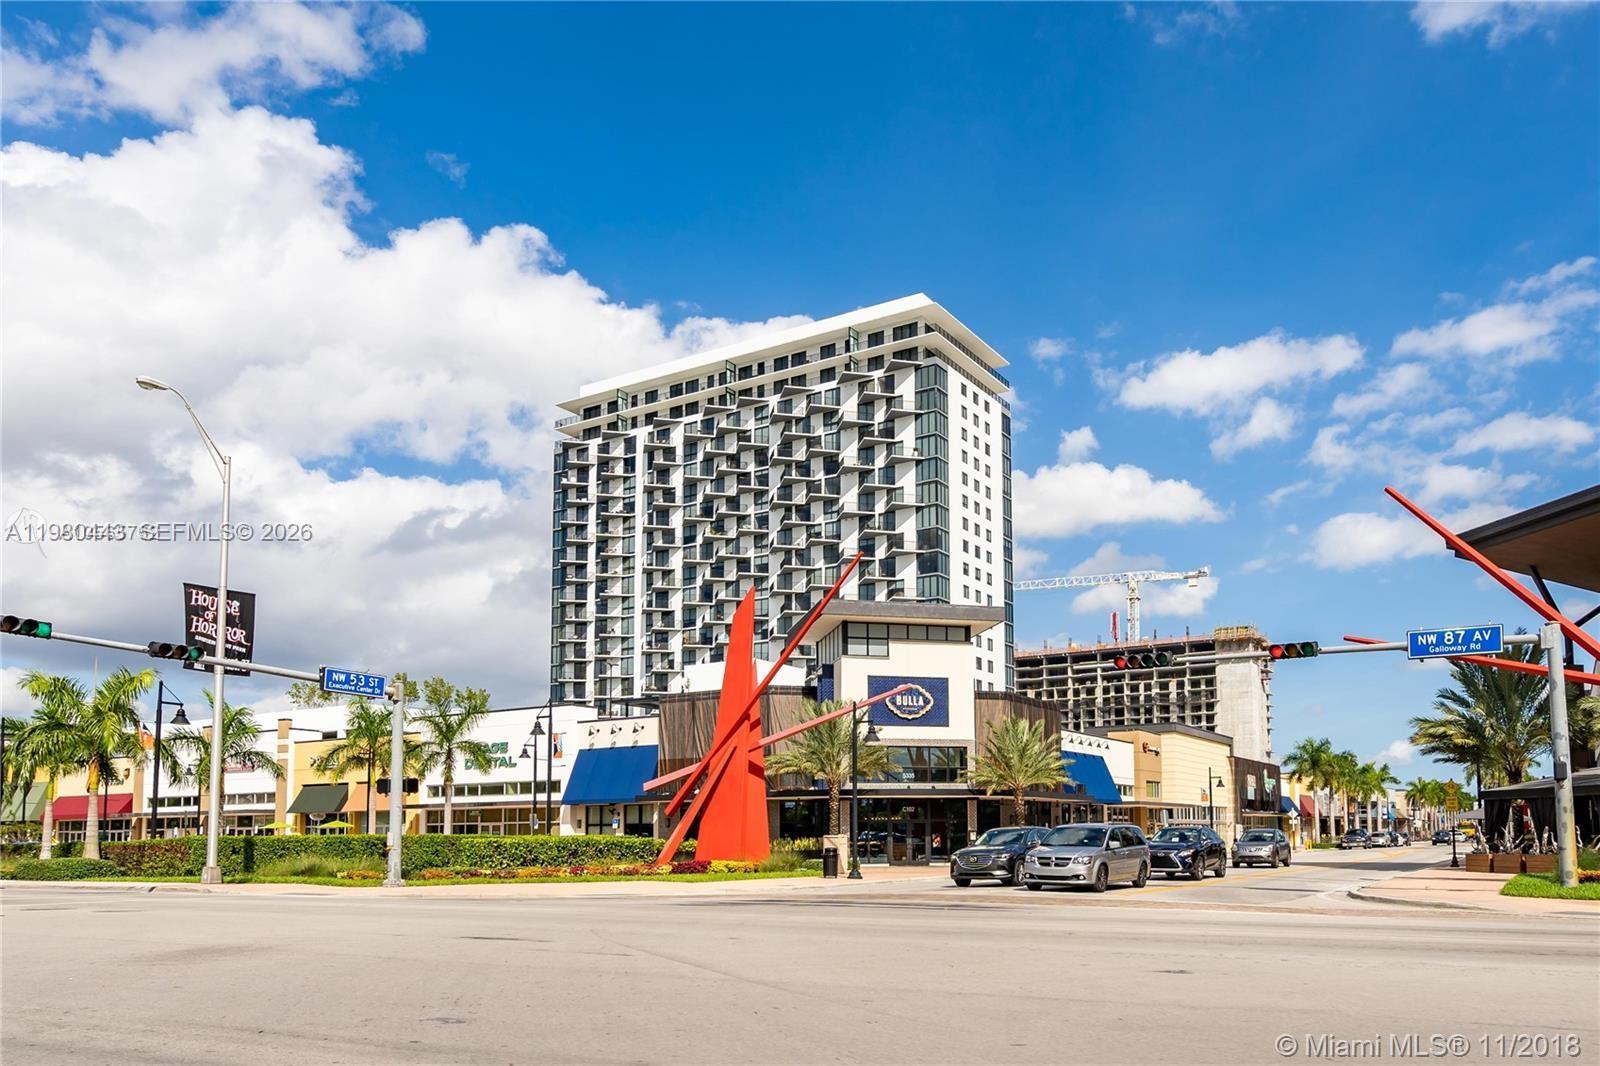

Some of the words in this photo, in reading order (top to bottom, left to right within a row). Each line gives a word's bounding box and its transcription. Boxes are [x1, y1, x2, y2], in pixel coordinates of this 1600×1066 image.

[1418, 633, 1437, 646] NW
[1444, 631, 1466, 645] 87
[1473, 629, 1491, 642] AV
[1429, 644, 1467, 653] Galloway
[1470, 642, 1481, 650] Rd
[332, 672, 347, 682] NW
[350, 674, 366, 686] 53
[369, 677, 379, 687] ST
[328, 681, 356, 691] Executive
[896, 695, 924, 706] BULLA
